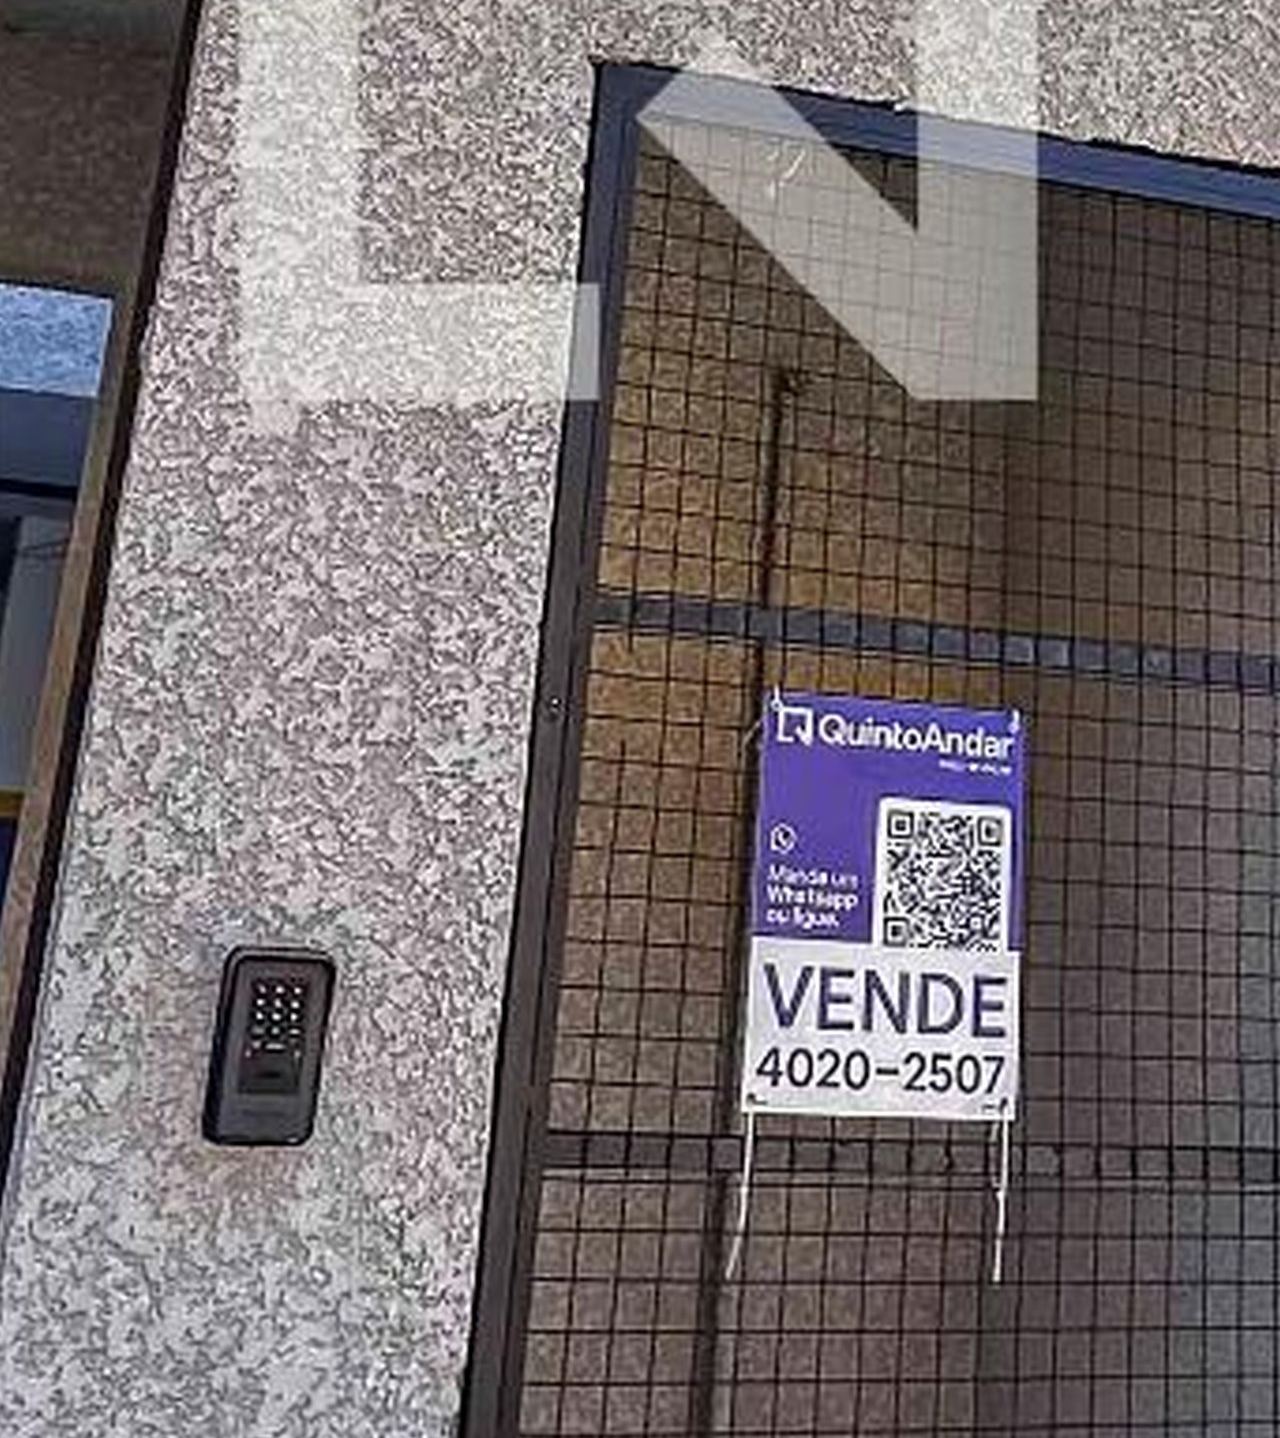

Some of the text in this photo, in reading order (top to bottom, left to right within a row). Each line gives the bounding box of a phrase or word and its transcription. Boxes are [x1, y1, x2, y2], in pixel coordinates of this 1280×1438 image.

[819, 714, 1014, 758] QuintoAndar
[766, 909, 791, 924] ou
[764, 962, 1008, 1038] VENDE
[756, 1046, 1006, 1095] 4020-2507
